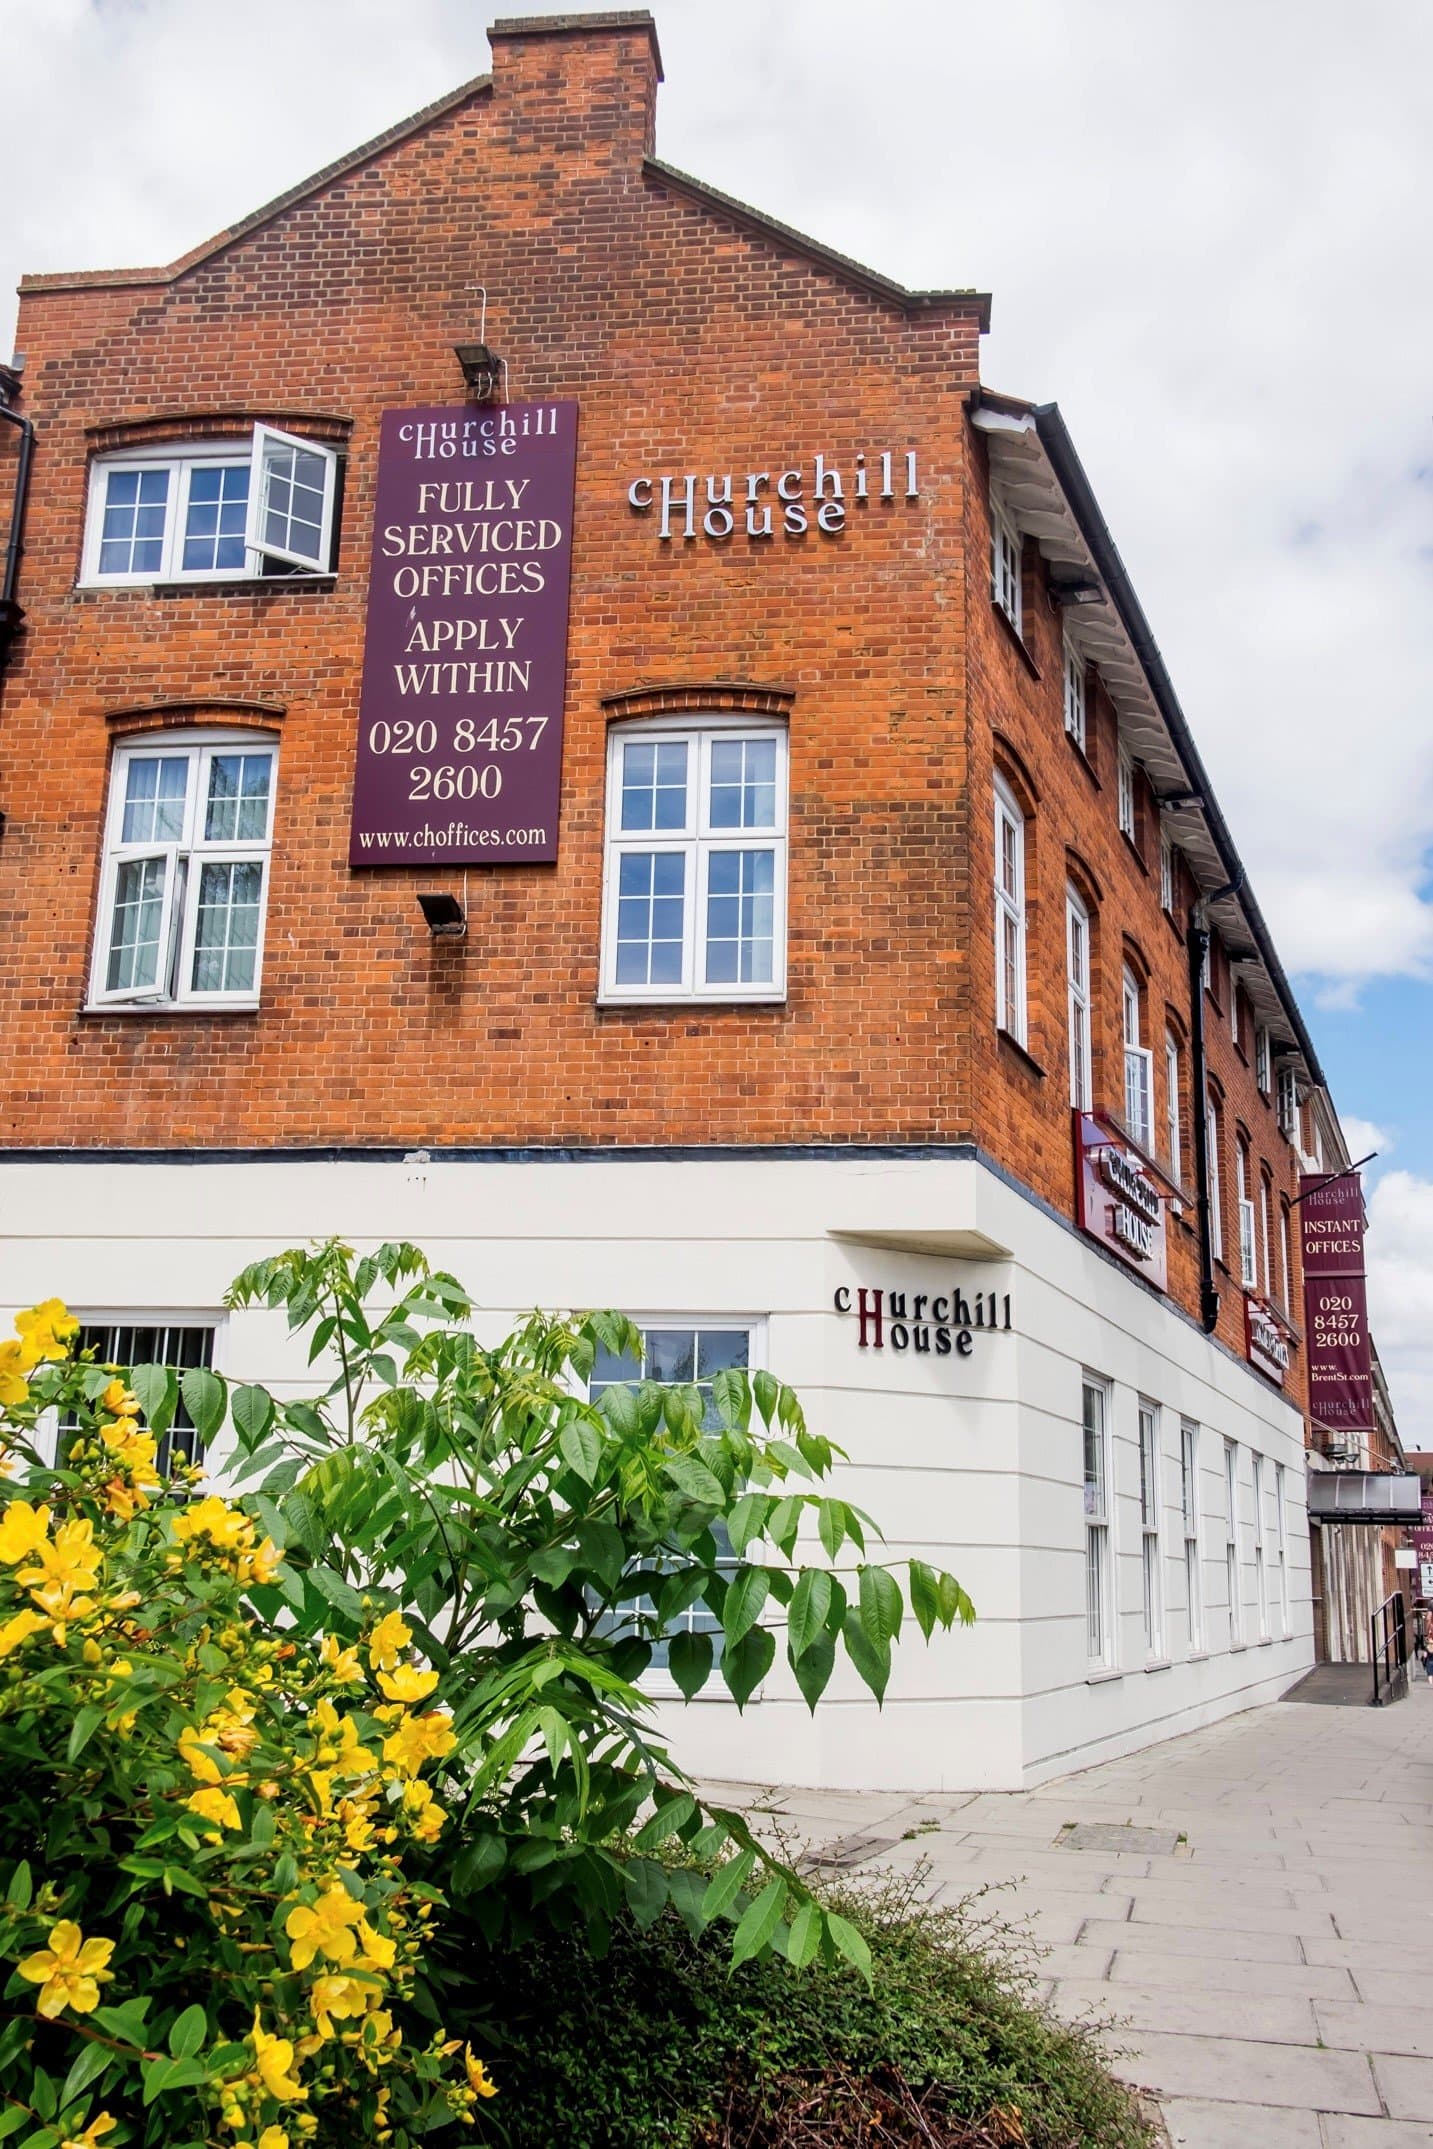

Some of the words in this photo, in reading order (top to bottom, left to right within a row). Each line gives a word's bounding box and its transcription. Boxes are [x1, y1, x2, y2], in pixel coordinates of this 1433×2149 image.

[417, 479, 530, 514] FULLY
[382, 519, 562, 556] SERVICED
[393, 561, 545, 598] OFFICES
[404, 618, 525, 652] APPLY
[393, 660, 532, 695] WITHIN
[369, 719, 438, 755] 020
[453, 716, 549, 752] 8457
[408, 764, 503, 800] 2600
[359, 822, 547, 848] www.choffices.com
[1304, 1219, 1361, 1234] INSTANT
[1306, 1240, 1361, 1254] OFFICES
[1319, 1296, 1352, 1311] 020
[1314, 1314, 1360, 1330] 8457
[1316, 1332, 1360, 1347] 2600
